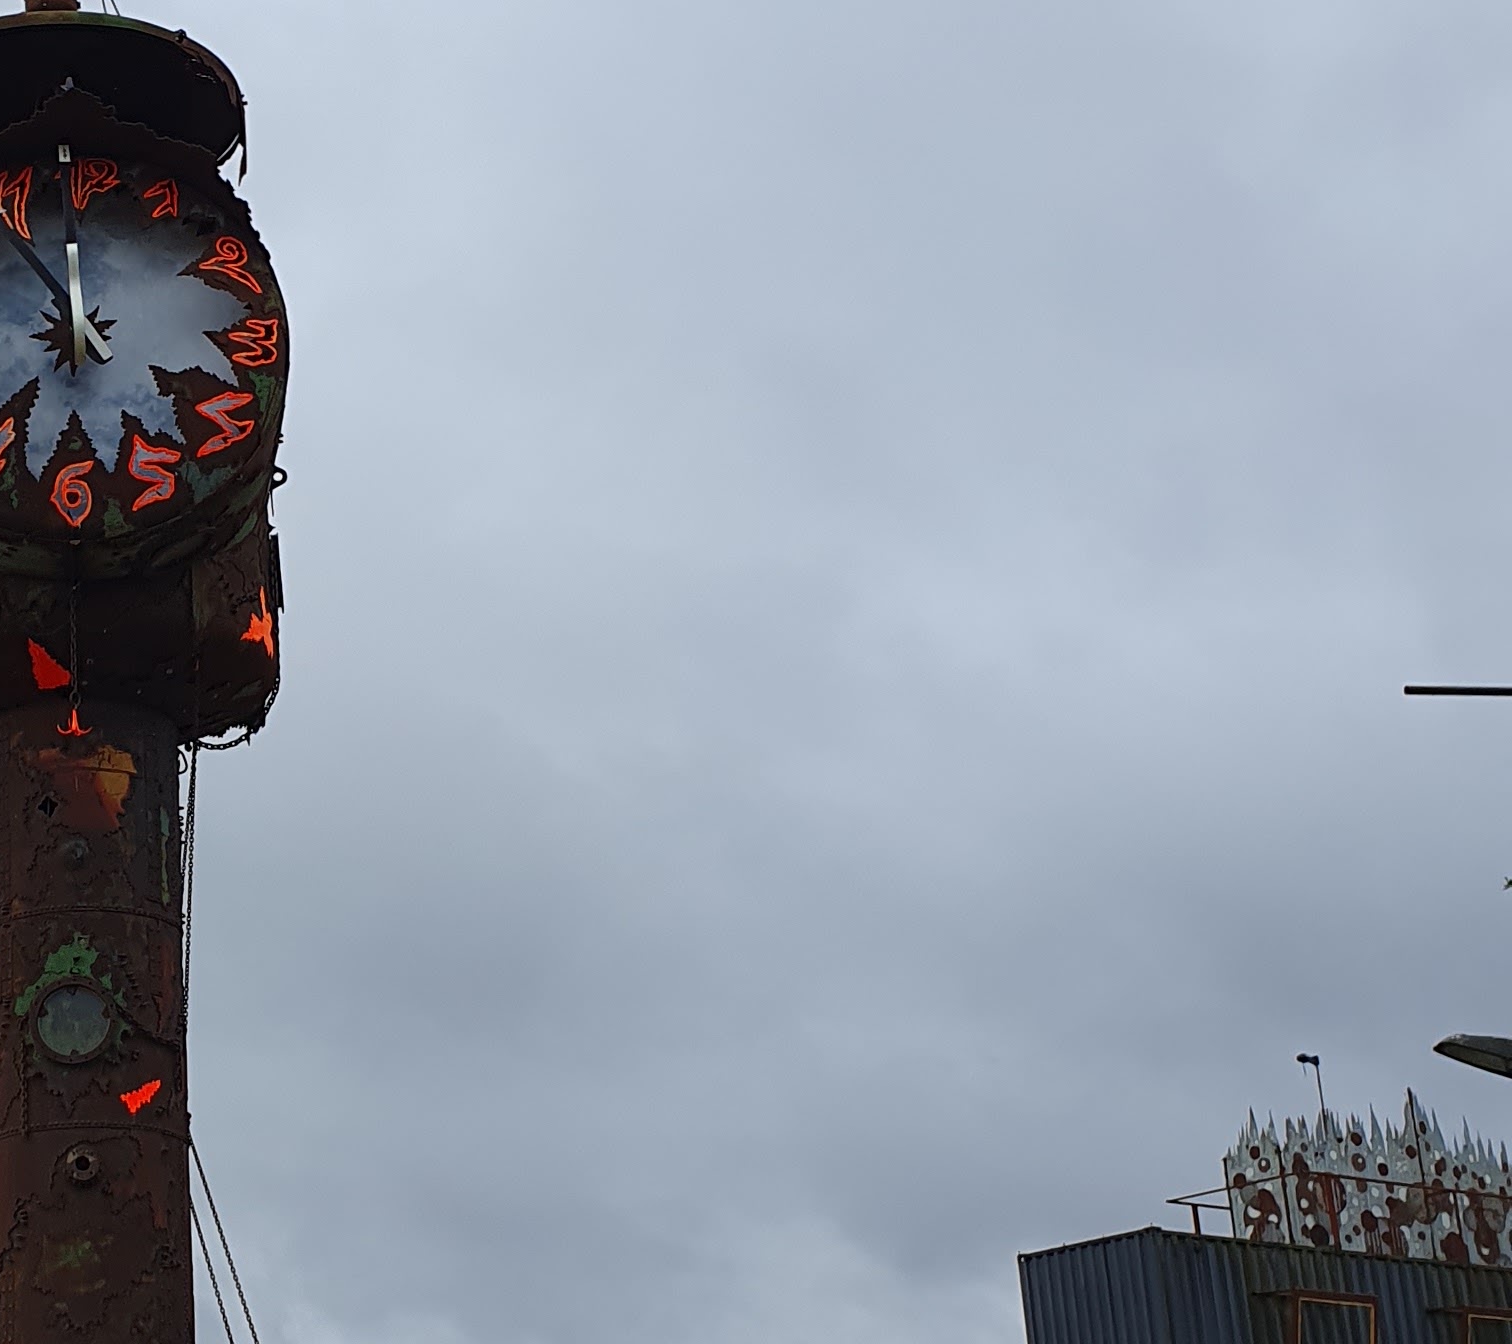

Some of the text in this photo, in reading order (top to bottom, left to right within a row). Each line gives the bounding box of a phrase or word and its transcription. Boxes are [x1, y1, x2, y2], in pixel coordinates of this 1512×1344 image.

[198, 235, 263, 294] 2
[227, 318, 279, 367] 3
[49, 460, 94, 527] 6
[129, 433, 182, 512] 5
